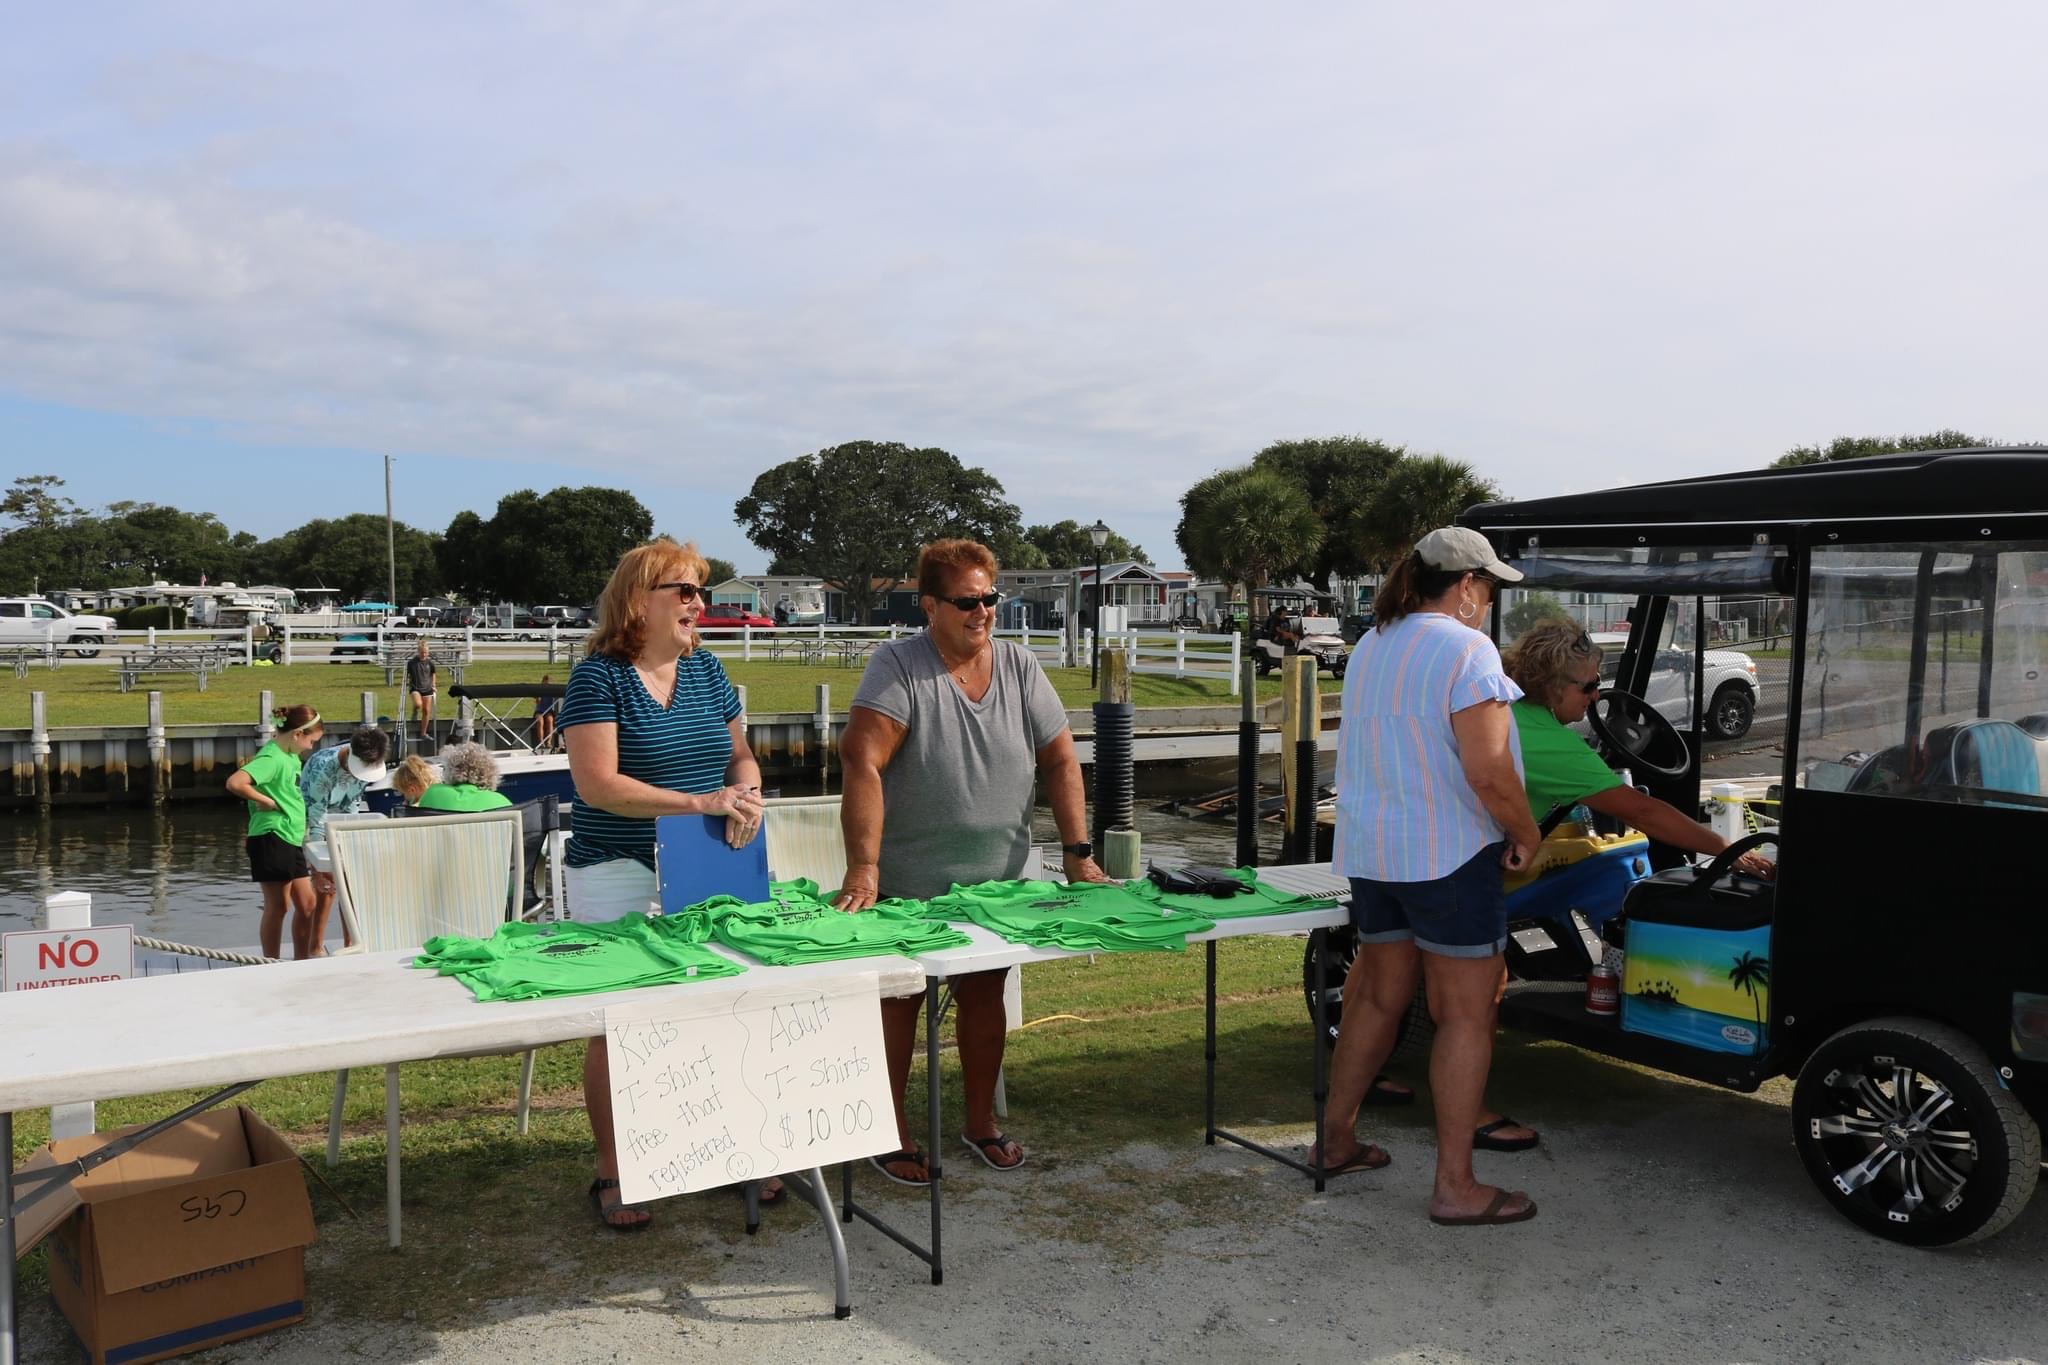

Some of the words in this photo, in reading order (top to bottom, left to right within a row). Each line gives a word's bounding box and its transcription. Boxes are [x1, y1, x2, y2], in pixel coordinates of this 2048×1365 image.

[38, 939, 99, 970] NO
[614, 1018, 678, 1072] Kids
[770, 994, 830, 1053] Adult
[626, 1128, 668, 1161] free
[676, 1083, 721, 1127] that
[648, 1124, 736, 1193] registered
